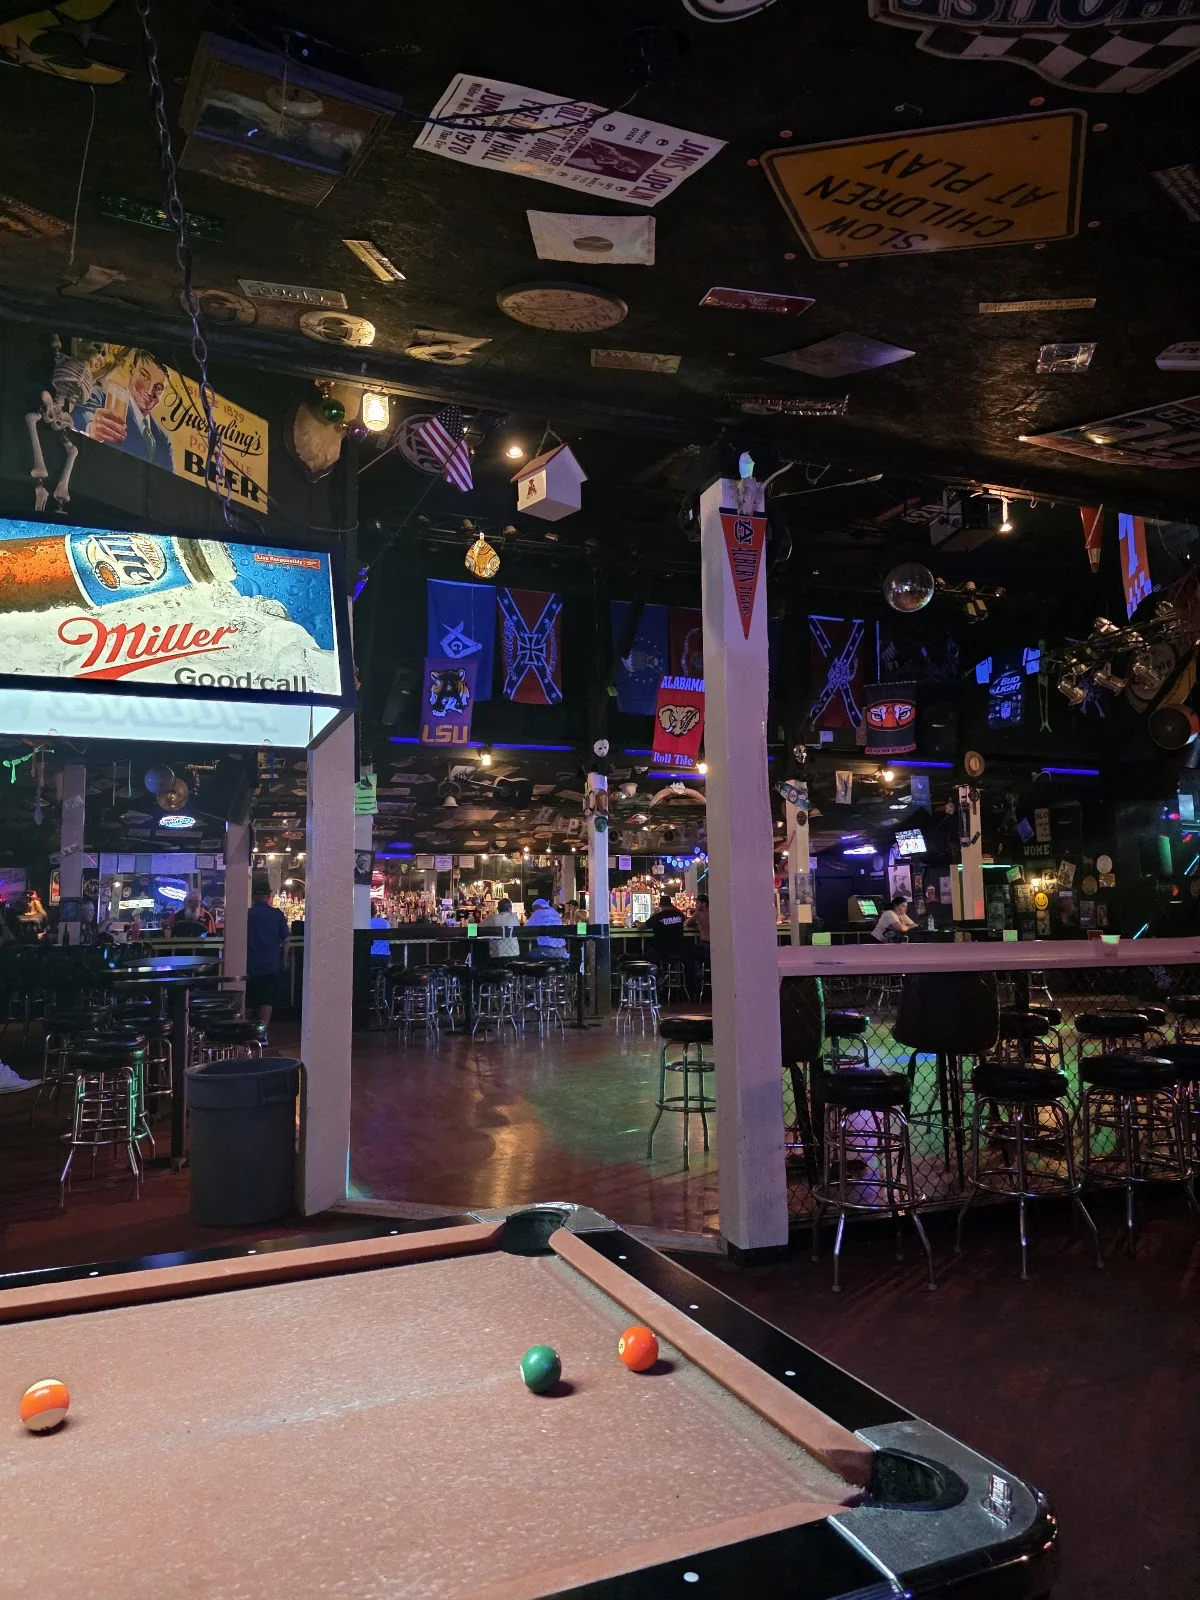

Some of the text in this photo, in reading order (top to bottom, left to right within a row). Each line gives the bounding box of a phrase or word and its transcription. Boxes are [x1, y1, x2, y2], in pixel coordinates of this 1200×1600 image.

[466, 82, 483, 97] Wilder
[471, 88, 506, 114] JUNE
[438, 129, 454, 141] Than
[481, 115, 508, 144] LOUIVILLE
[623, 127, 640, 142] OVER
[634, 130, 651, 145] MOVE
[447, 131, 477, 155] 1970
[481, 141, 517, 163] HALL
[524, 138, 561, 163] BOOGIE
[549, 154, 569, 167] HER
[625, 138, 710, 201] JANIS JOPLIN
[863, 149, 1059, 209] AT PLAY
[804, 174, 1014, 239] CHILDREN
[812, 215, 928, 251] SLOW
[187, 385, 245, 423] SICE 1829
[161, 392, 264, 457] Yuegling's
[189, 435, 253, 477] POSVILLE
[184, 448, 259, 503] BEER
[270, 556, 303, 565] Responsibly
[731, 545, 758, 616] AUBURN TIGERS
[58, 617, 239, 670] Miller
[174, 667, 252, 688] Good
[660, 675, 706, 692] ALABAMA
[996, 682, 1022, 693] LIGHT
[1000, 675, 1021, 686] BUD
[422, 724, 469, 744] LSU
[652, 751, 694, 766] Roll Tide
[501, 926, 514, 938] 17
